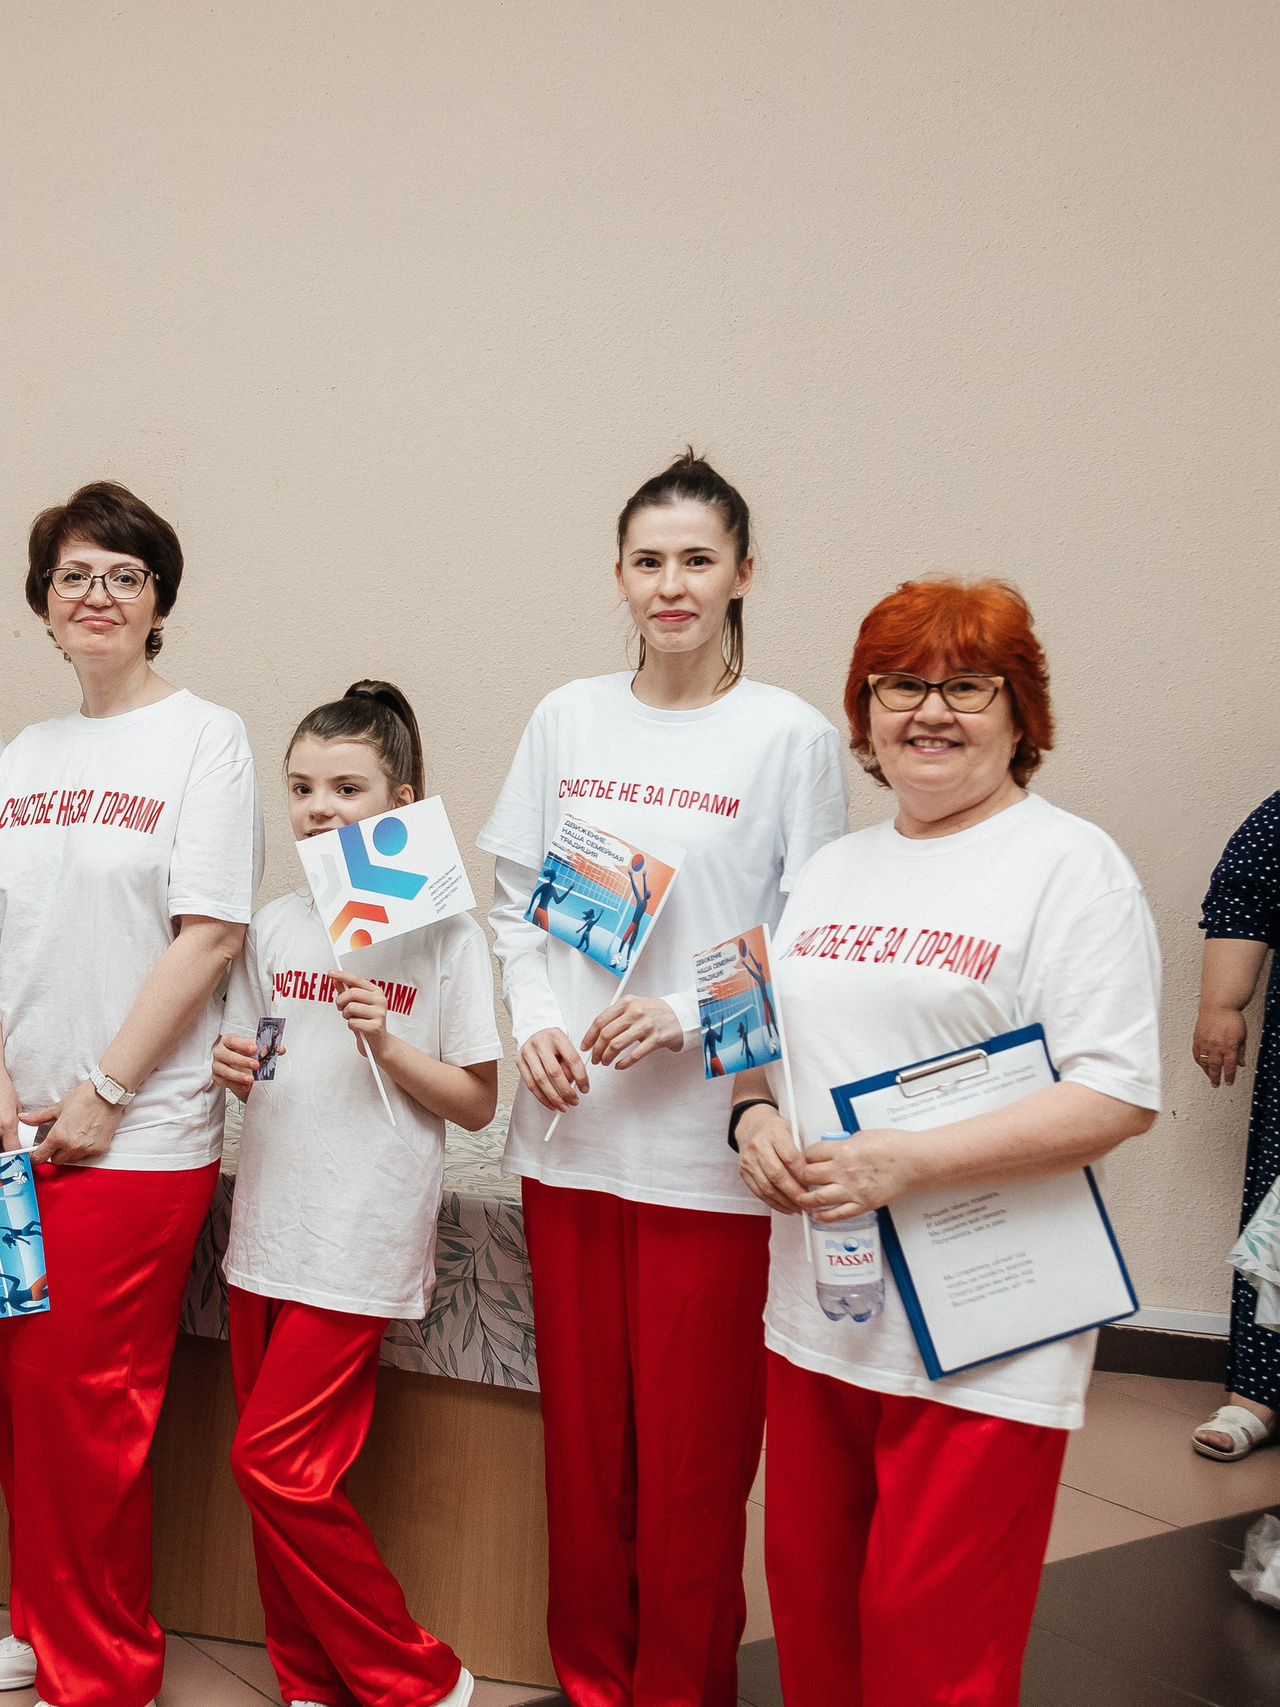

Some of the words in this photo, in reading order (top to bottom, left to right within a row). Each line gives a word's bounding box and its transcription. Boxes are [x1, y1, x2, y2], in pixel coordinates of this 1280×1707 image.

[71, 789, 94, 824] ЗА
[93, 791, 165, 835] ГОРАМИ
[558, 779, 617, 800] СЧАСТЬЕ
[618, 782, 641, 803] НЕ
[643, 785, 664, 806] ЗА
[668, 788, 740, 819] ГОРАМИ
[560, 835, 598, 859] ТРАДИЦИЯ
[562, 827, 584, 842] НАША
[586, 839, 625, 863] СЕМЕЙНАЯ
[564, 820, 607, 845] ДВИЖЕНИЕ
[845, 925, 884, 962] НЕ
[874, 927, 908, 963] ЗА
[903, 929, 1002, 984] ГОРАМИ
[272, 970, 318, 1001] ЧСТЬЕ
[826, 1252, 875, 1266] TASSAY
